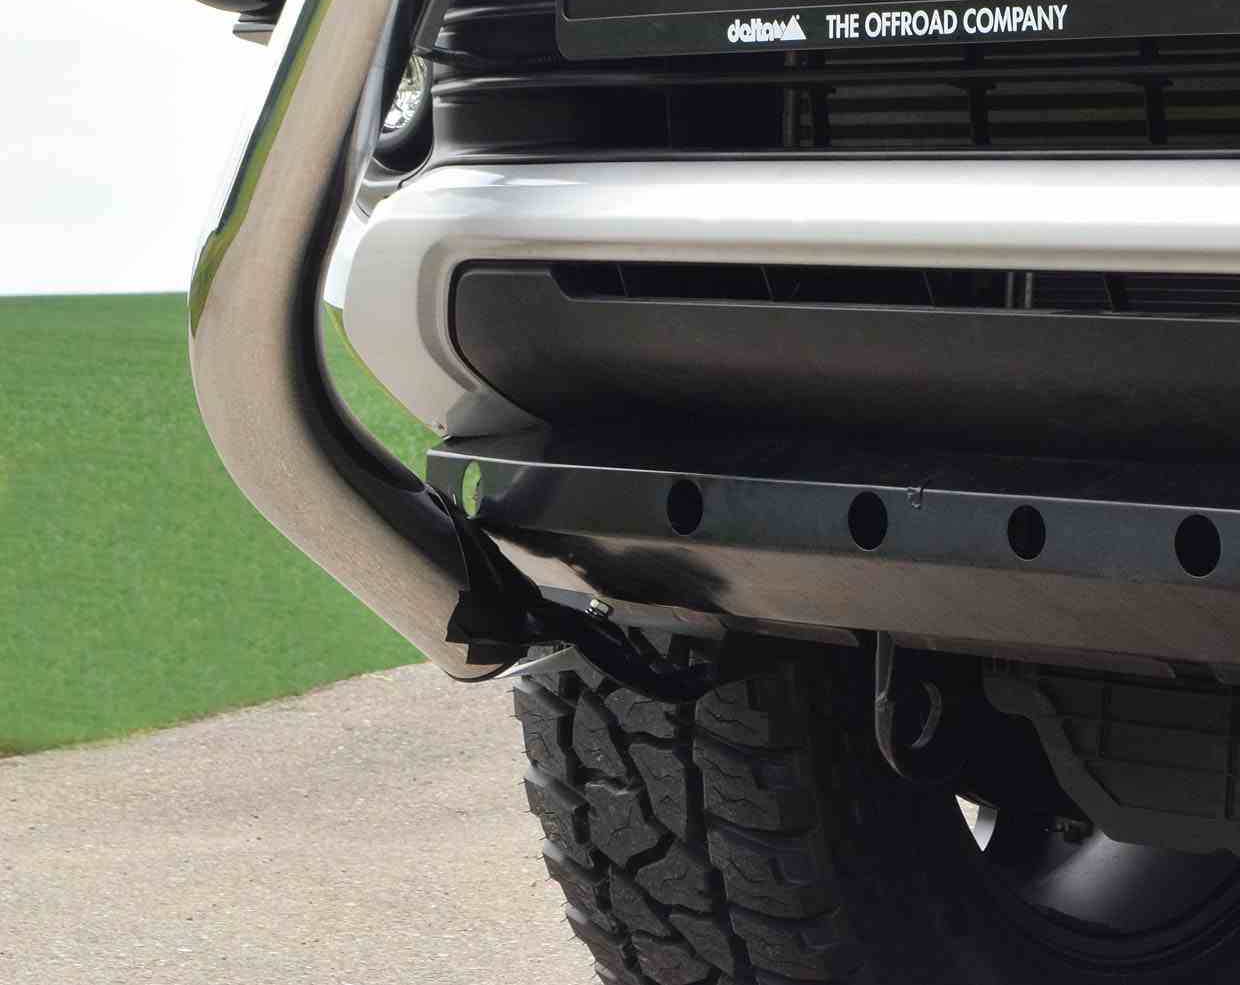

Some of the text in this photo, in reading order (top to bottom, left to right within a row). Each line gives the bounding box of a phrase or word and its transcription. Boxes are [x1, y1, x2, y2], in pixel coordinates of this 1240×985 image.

[826, 14, 859, 39] THE
[864, 9, 957, 38] OFFROAD
[963, 4, 1068, 35] COMPANY
